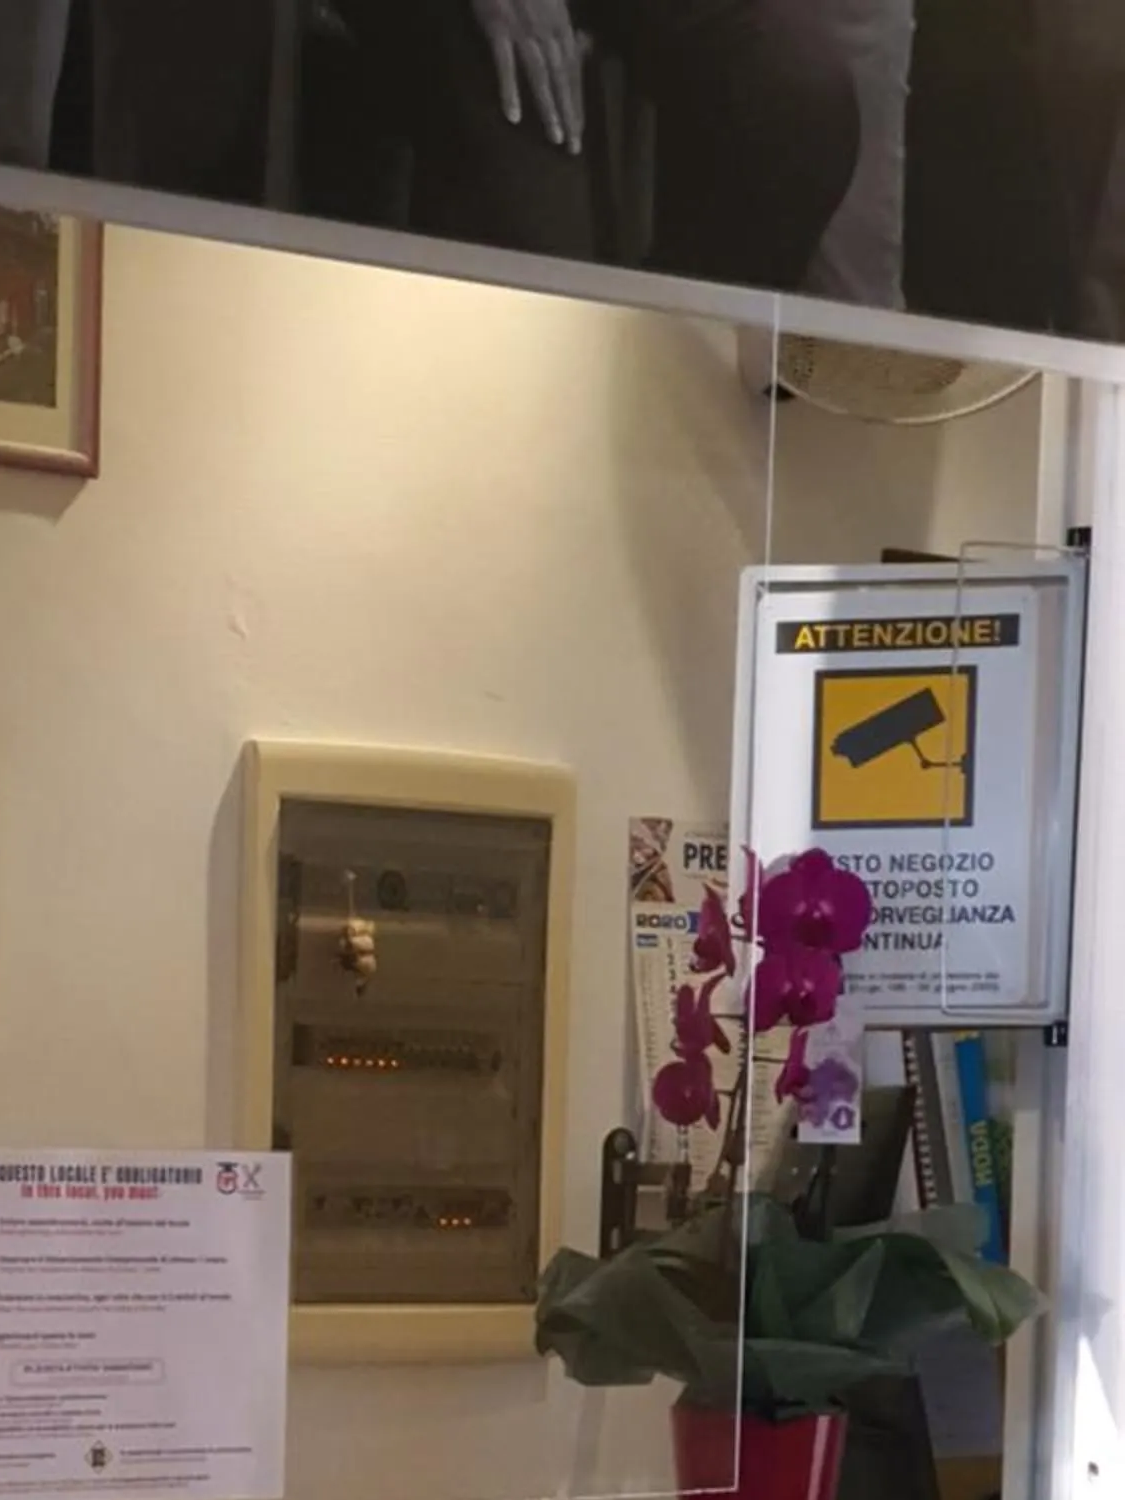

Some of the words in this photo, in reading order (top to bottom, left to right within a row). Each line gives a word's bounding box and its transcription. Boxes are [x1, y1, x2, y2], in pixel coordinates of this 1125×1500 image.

[794, 619, 1002, 650] ATTENZIONE!
[889, 851, 995, 873] NEGOZIO
[50, 1165, 97, 1184] LOCALE
[116, 1166, 202, 1185] OBBLIGATORIO
[104, 1187, 125, 1202] you
